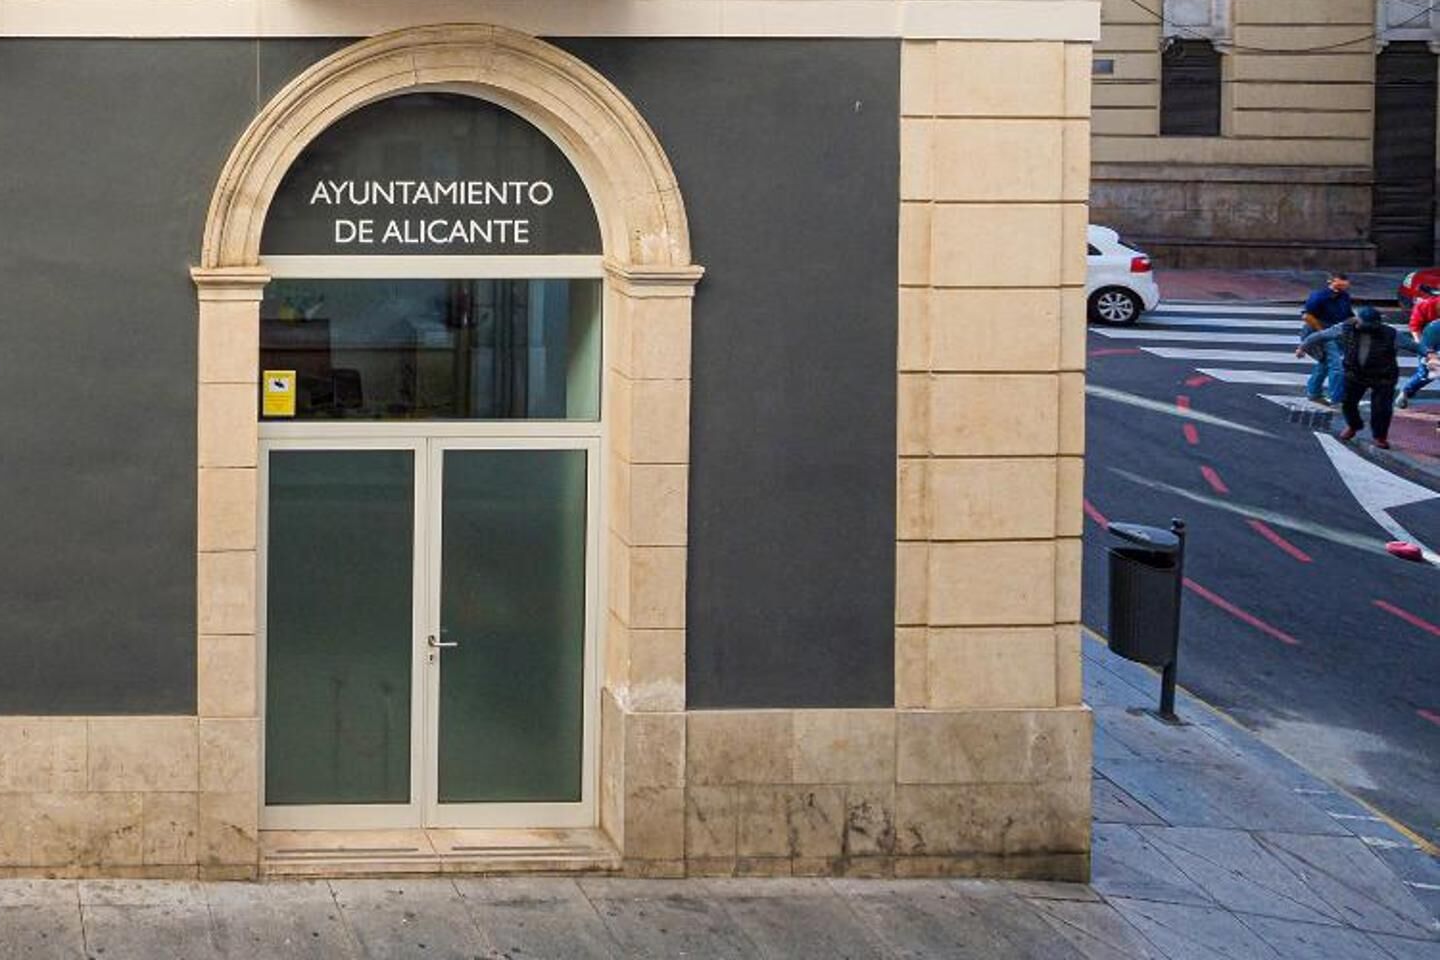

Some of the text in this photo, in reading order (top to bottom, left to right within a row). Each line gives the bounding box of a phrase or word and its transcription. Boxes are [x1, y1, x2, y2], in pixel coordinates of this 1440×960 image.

[310, 180, 554, 205] AYUNTAMIENTO
[335, 219, 530, 244] DE ALICANTE
